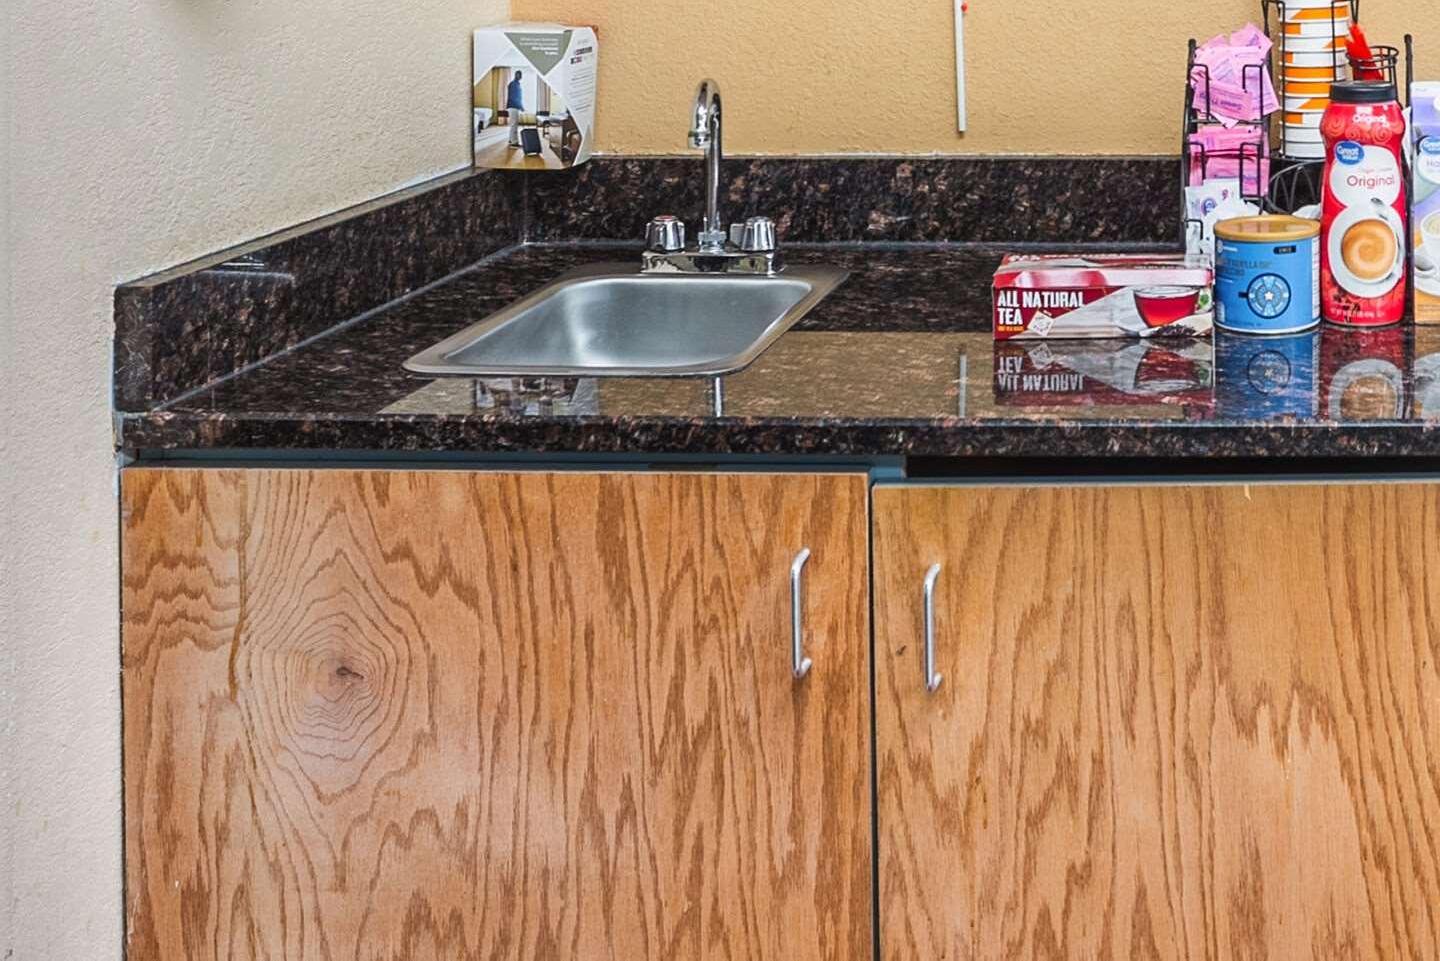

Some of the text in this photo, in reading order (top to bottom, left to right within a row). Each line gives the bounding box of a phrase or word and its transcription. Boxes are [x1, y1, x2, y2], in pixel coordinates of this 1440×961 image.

[1347, 174, 1395, 190] Original
[997, 290, 1084, 309] ALL NATURAL
[997, 308, 1023, 325] TEA
